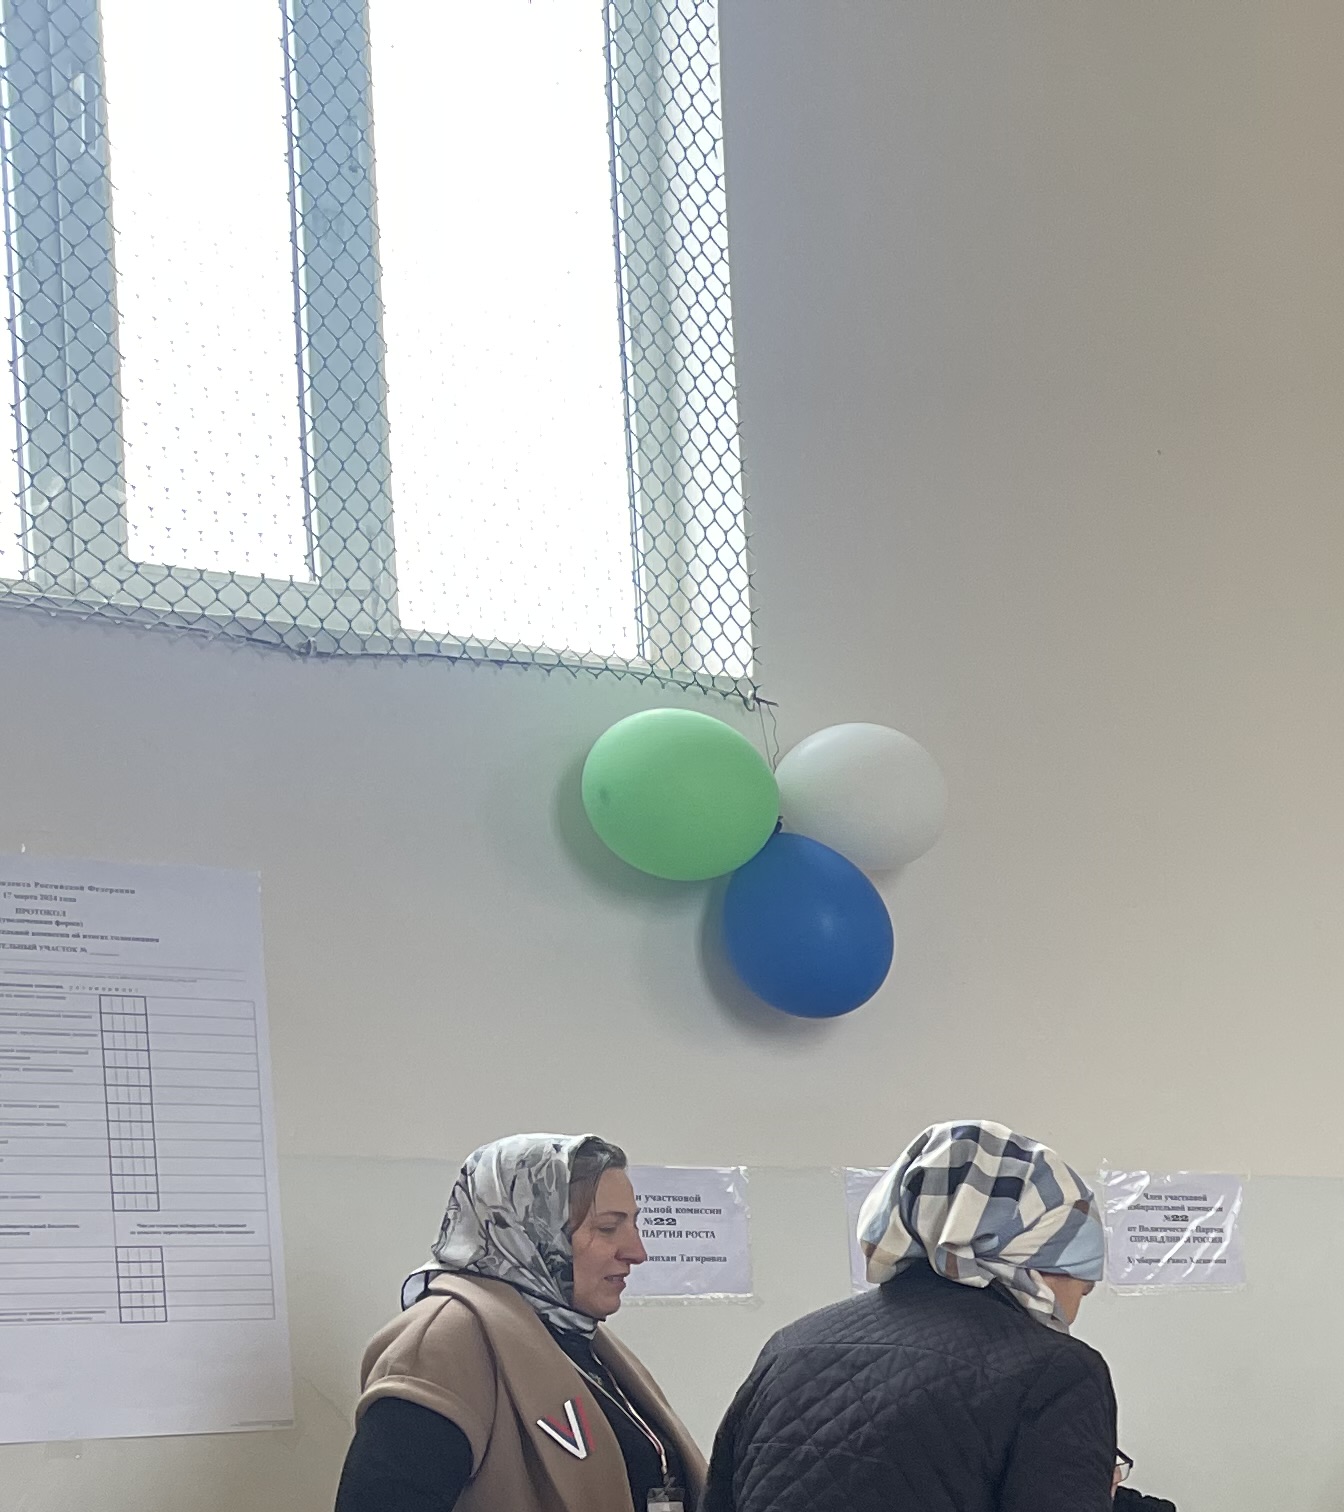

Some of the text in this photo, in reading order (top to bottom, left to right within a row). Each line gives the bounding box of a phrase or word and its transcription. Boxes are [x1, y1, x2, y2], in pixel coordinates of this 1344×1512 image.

[645, 1194, 702, 1204] участковой
[675, 1207, 722, 1215] комиссии
[643, 1217, 677, 1226] №22
[642, 1229, 716, 1239] ПАРТИЯ РОСТА
